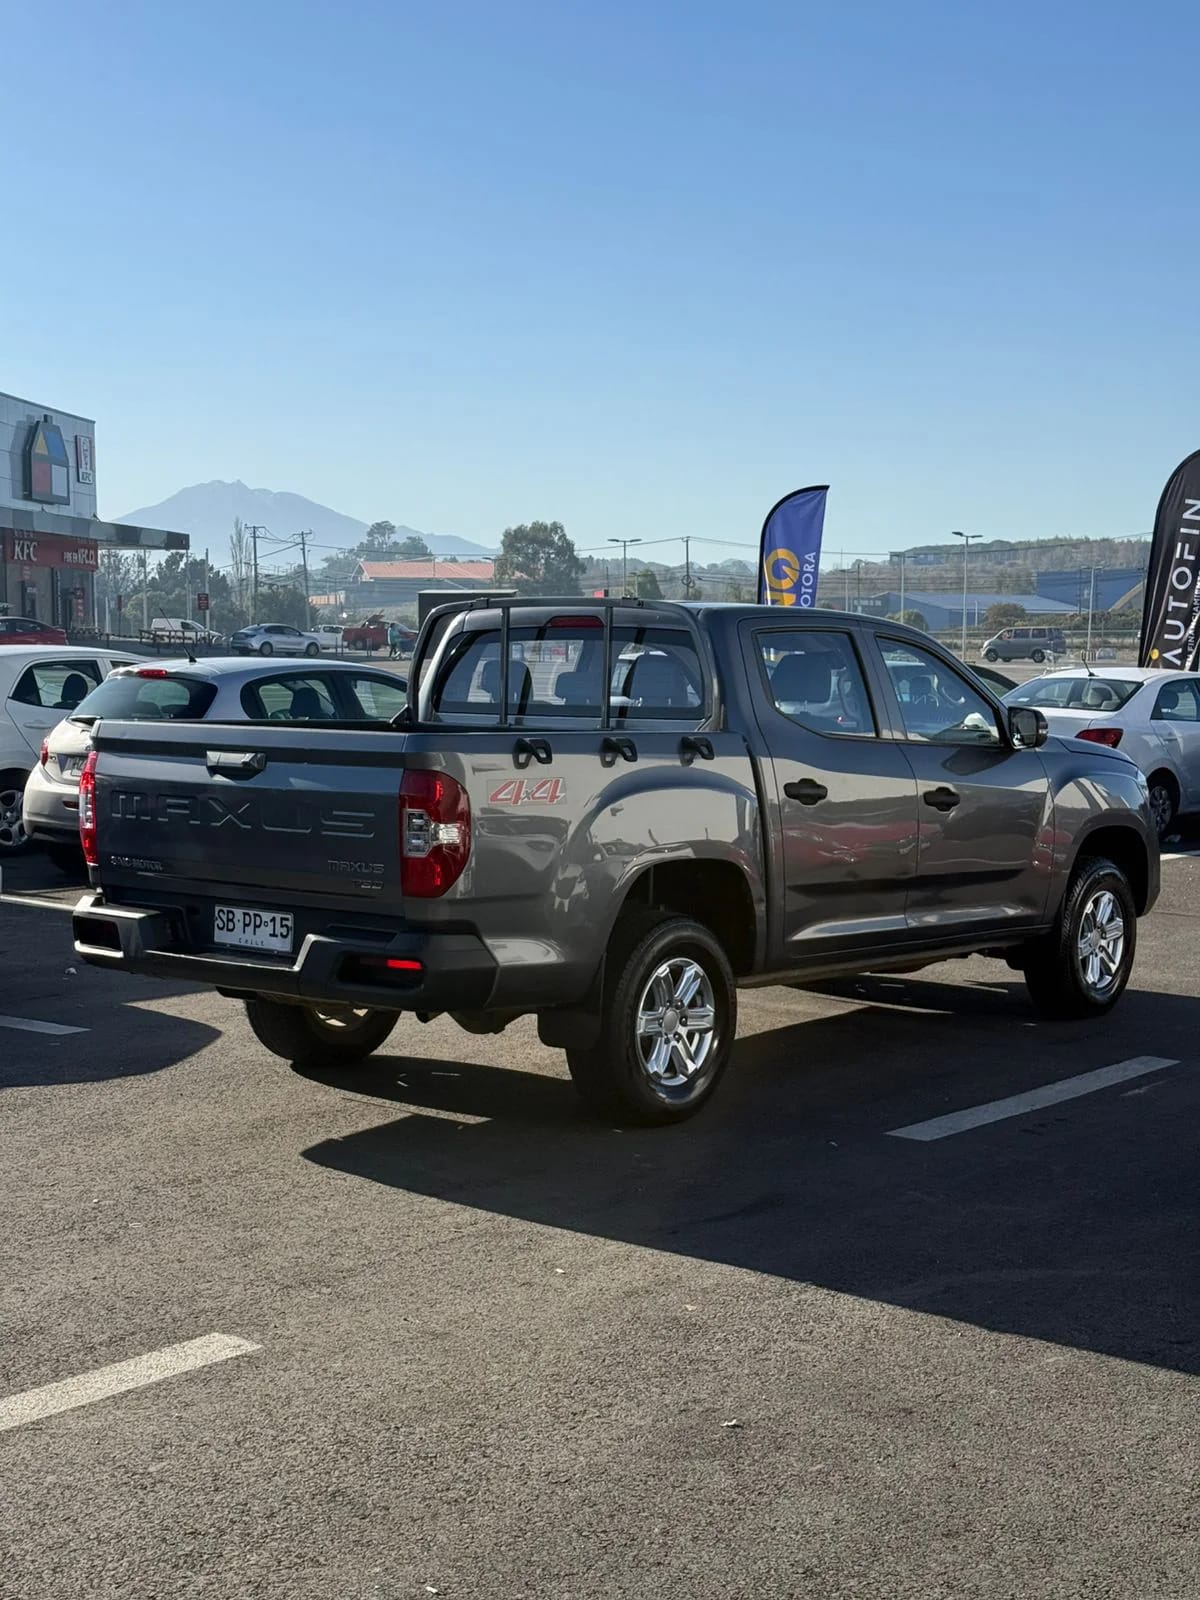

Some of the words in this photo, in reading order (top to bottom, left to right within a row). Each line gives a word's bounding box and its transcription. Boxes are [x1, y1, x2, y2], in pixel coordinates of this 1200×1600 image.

[14, 540, 38, 562] KFC
[1162, 498, 1200, 666] AUTOFIN
[489, 778, 565, 805] 4x4
[111, 790, 375, 838] MAXUS
[328, 860, 385, 873] MAXUS
